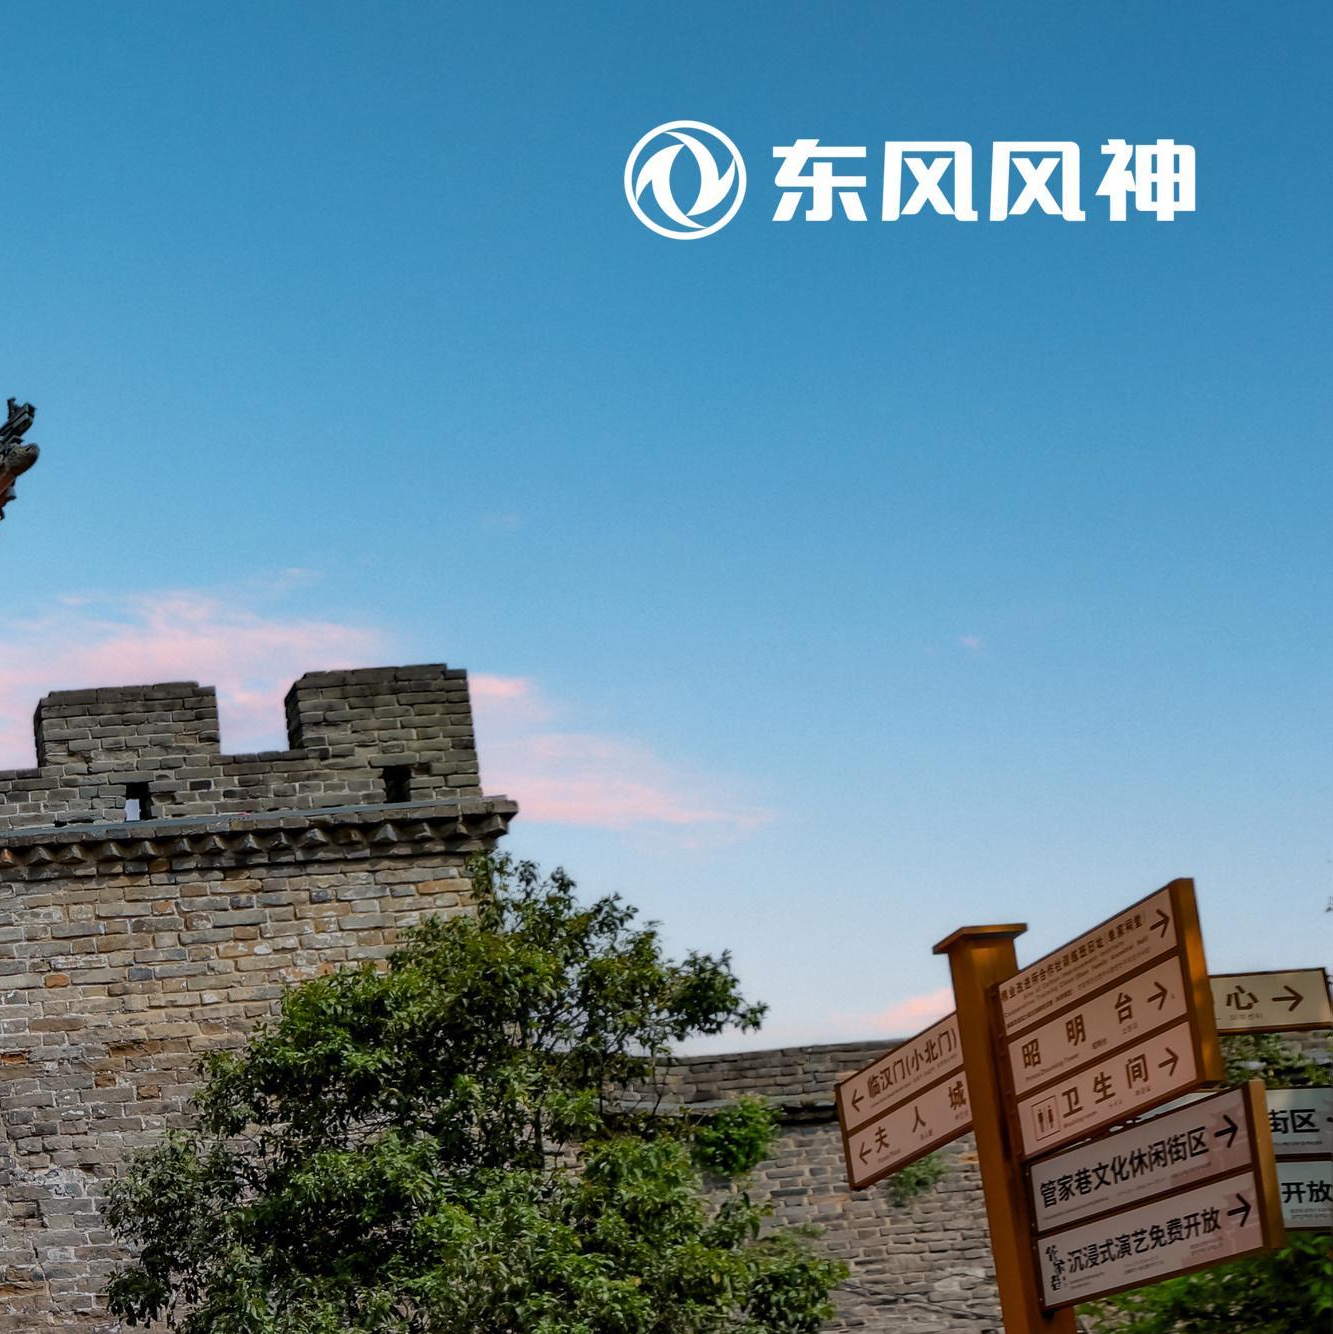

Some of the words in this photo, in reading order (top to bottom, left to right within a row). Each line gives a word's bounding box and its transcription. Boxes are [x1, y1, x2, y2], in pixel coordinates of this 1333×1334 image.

[1021, 992, 1133, 1069] 昭明台
[1225, 985, 1259, 1011] 心
[874, 1080, 967, 1154] 夫人城
[1062, 1053, 1149, 1119] 卫生间
[1268, 1108, 1320, 1135] 街区
[1039, 1125, 1210, 1209] 管家巷文化休闲街区
[1281, 1179, 1333, 1204] 开放
[1067, 1206, 1222, 1274] 沉浸式演艺免费开放
